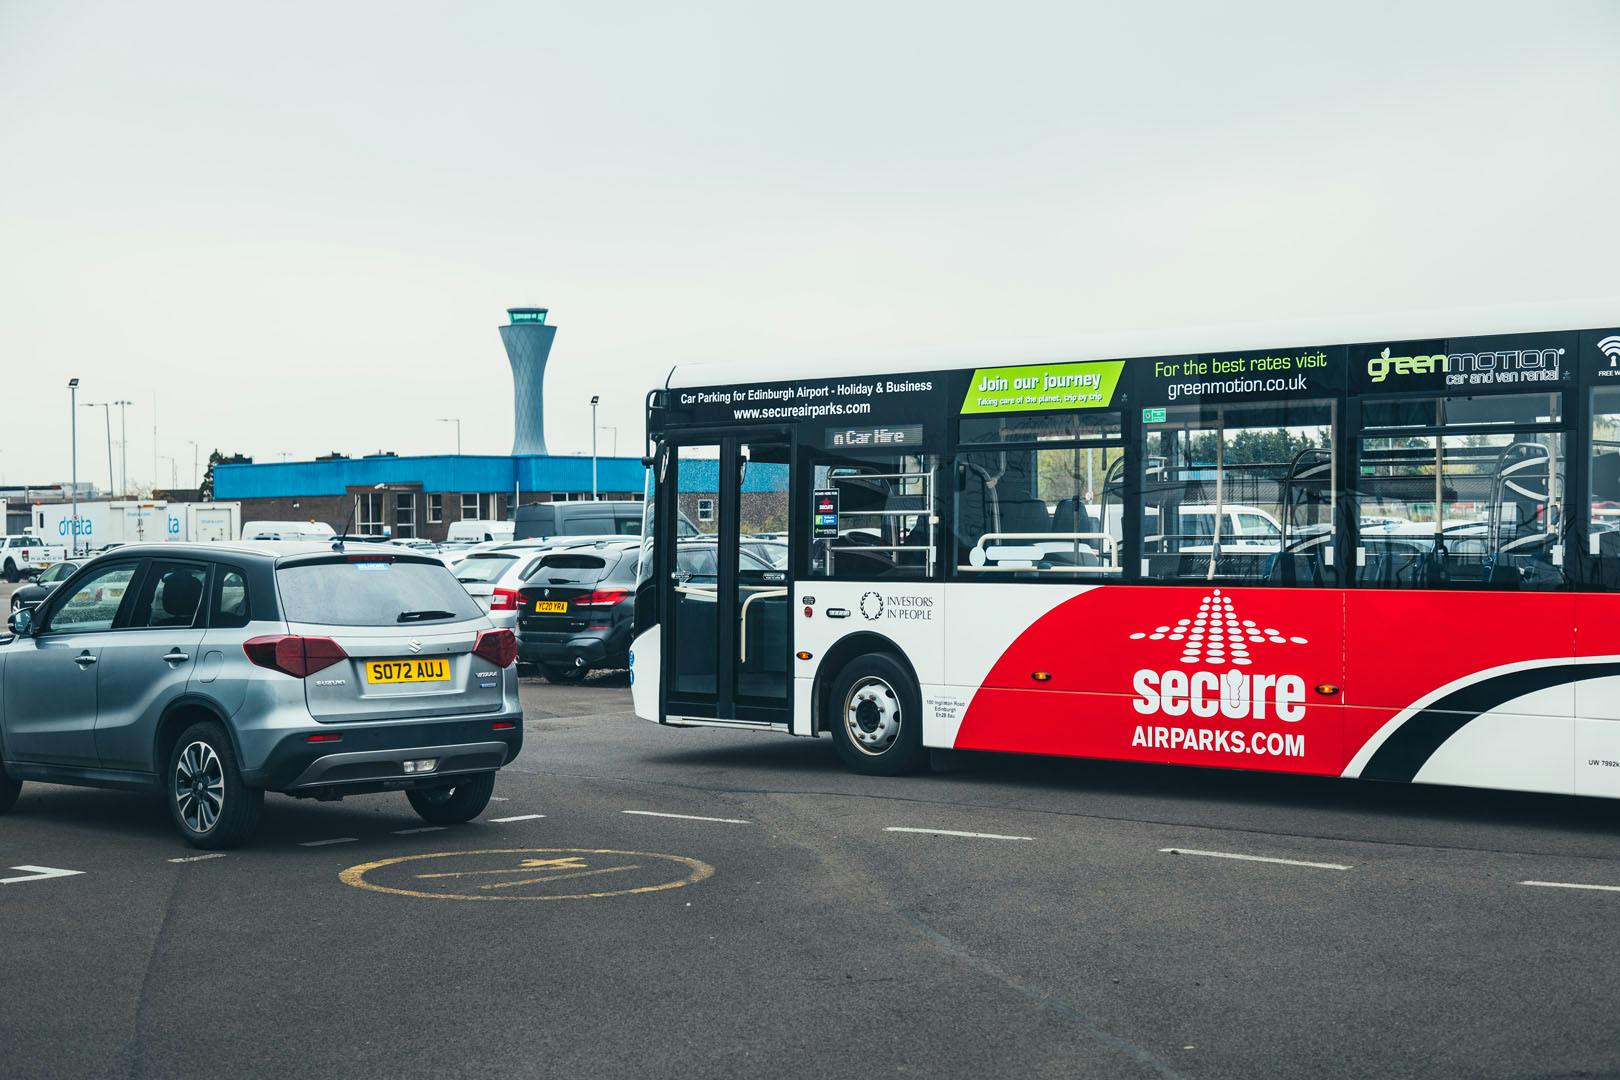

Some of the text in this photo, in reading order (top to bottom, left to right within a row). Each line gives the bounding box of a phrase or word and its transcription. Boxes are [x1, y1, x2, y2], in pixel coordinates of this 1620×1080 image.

[1155, 351, 1327, 377] For the best rates visit
[978, 373, 1102, 392] Join our journey
[1446, 366, 1560, 385] car and van rental
[680, 393, 696, 404] Car
[698, 392, 731, 404] Parking
[733, 391, 746, 401] for
[748, 387, 795, 401] Edinburgh
[796, 385, 829, 399] Airport
[837, 383, 873, 397] Holiday
[875, 382, 884, 393] &
[886, 380, 933, 393] Business
[1168, 373, 1307, 400] greenmotion.co.uk
[978, 398, 998, 407] Taking
[1025, 395, 1037, 404] the
[733, 402, 871, 420] www.secureairparks.com
[845, 430, 873, 444] Car
[873, 428, 905, 443] Hire
[887, 596, 934, 607] INVESTORS
[887, 609, 932, 620] IN PEOPLE
[373, 661, 444, 680] SO72 AUJ
[1132, 669, 1306, 722] secure
[1132, 726, 1305, 757] AIRPARKS.COM
[1601, 760, 1620, 768] 7992k
